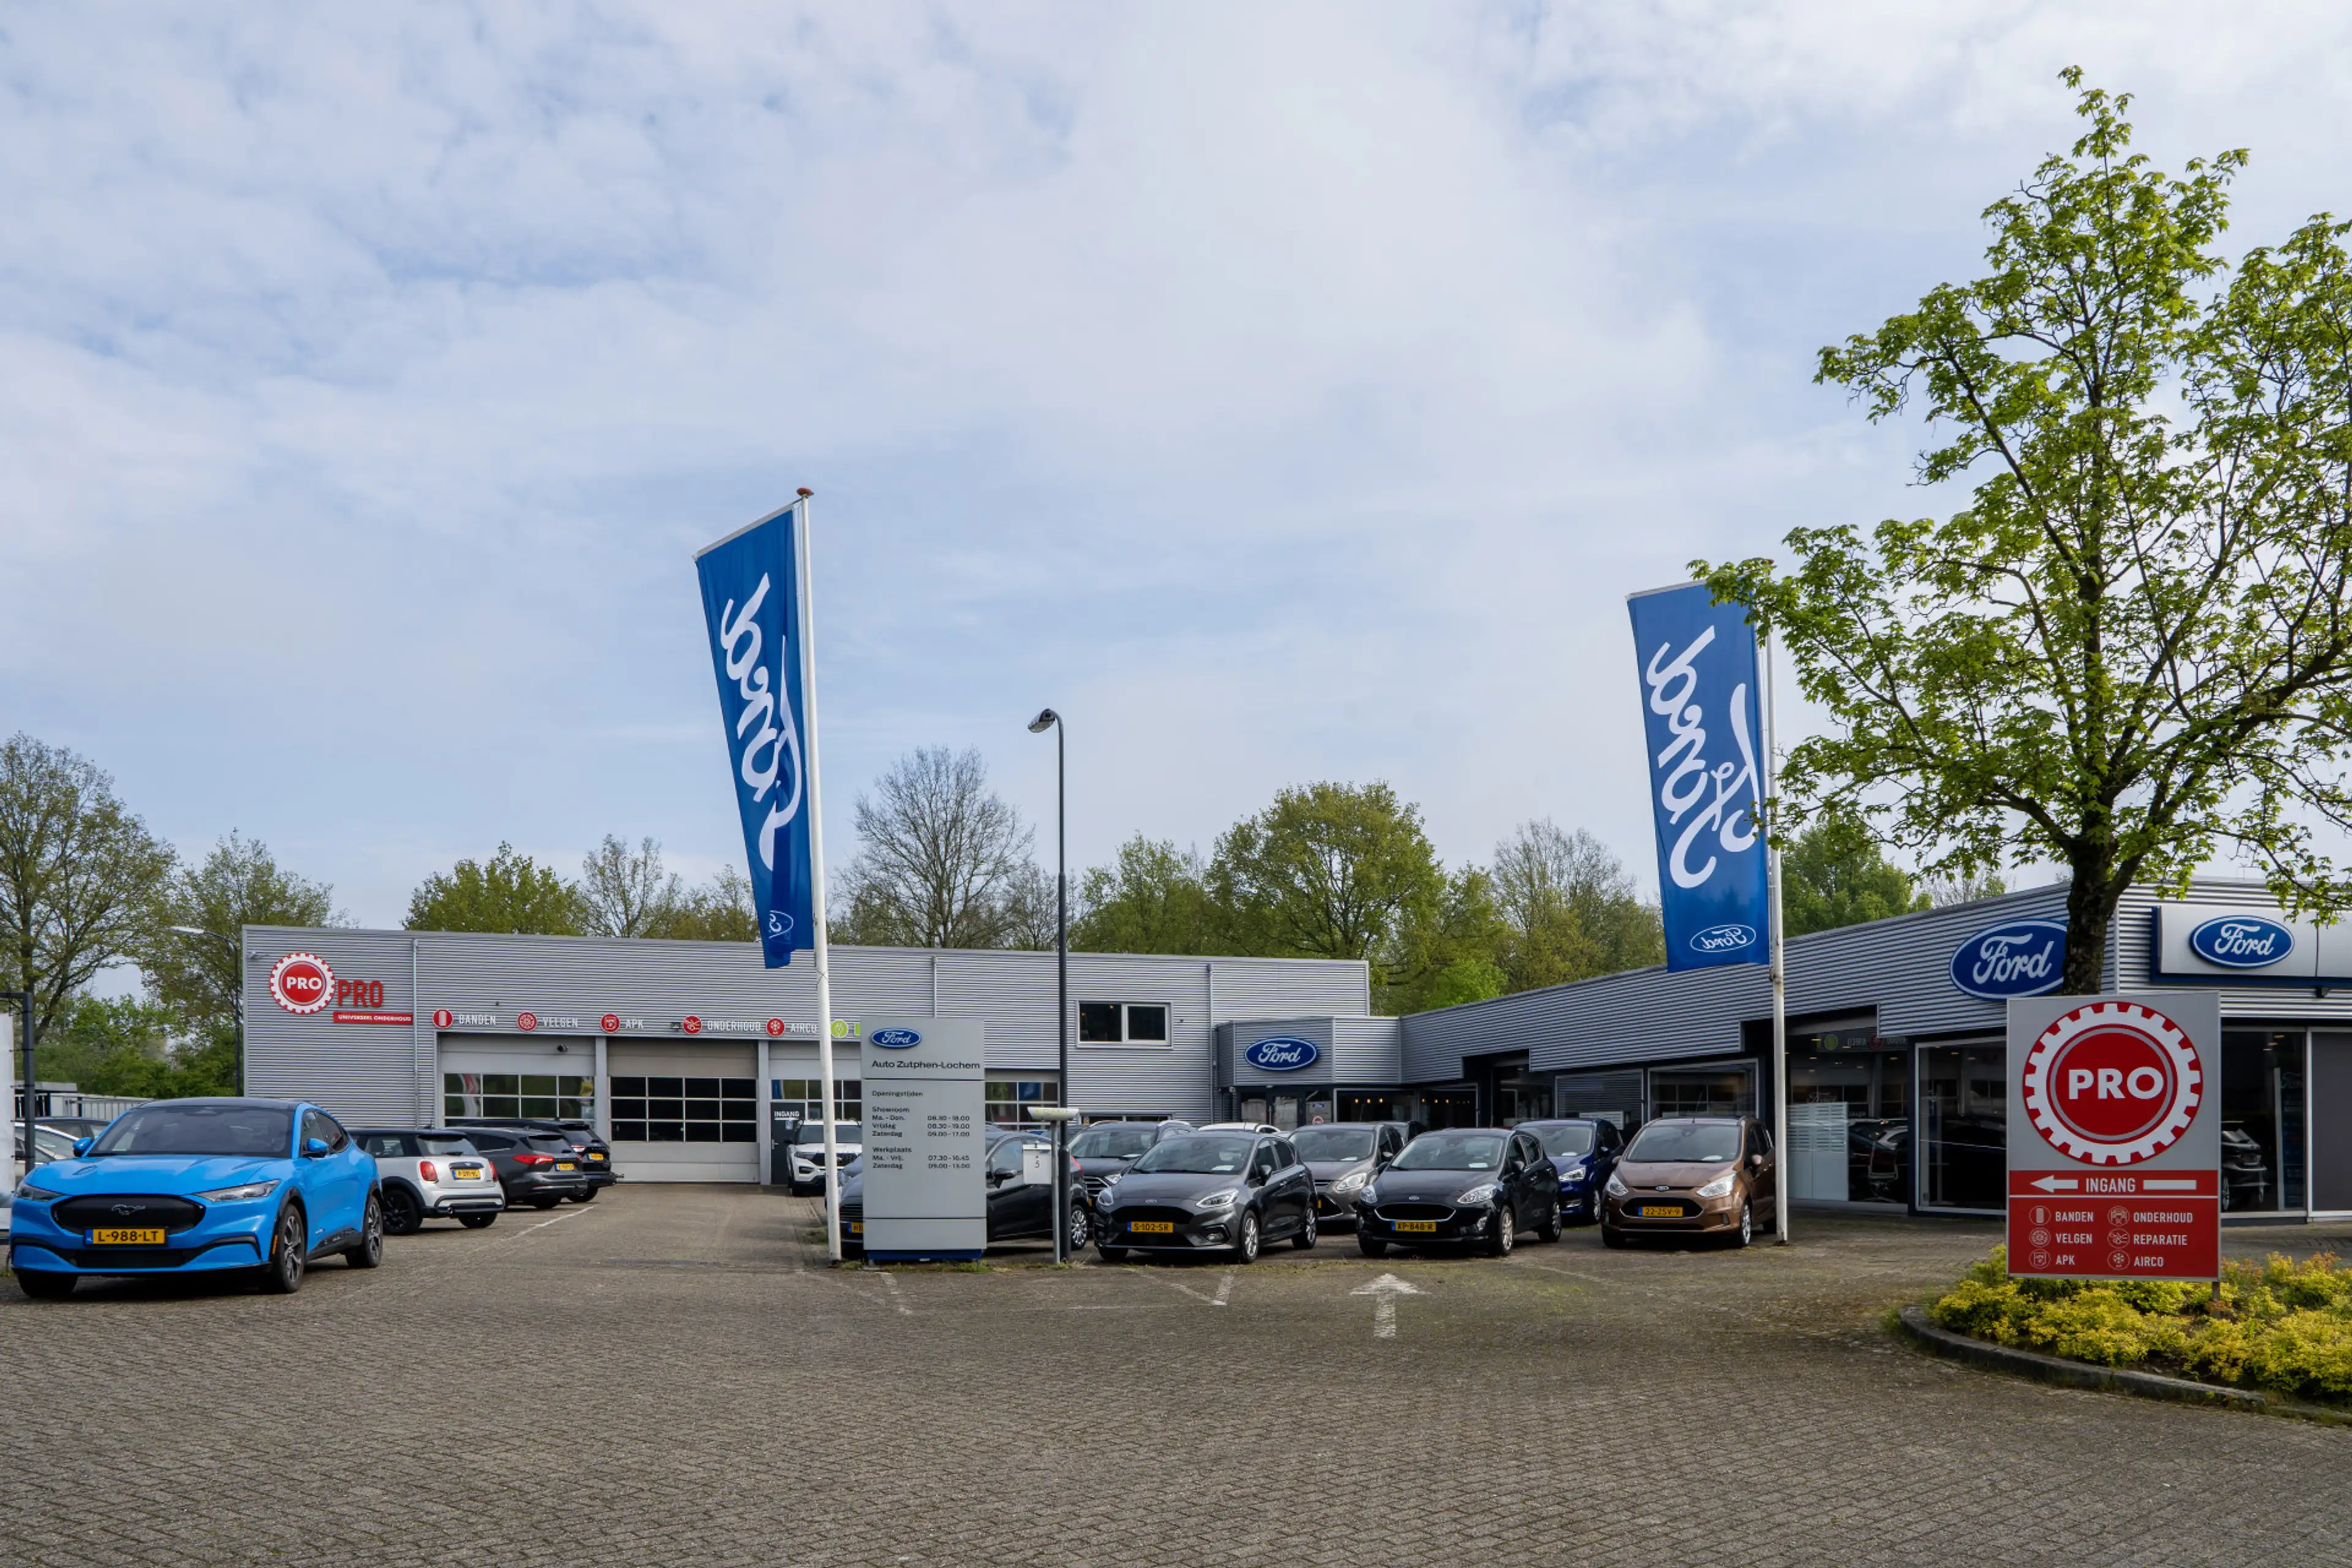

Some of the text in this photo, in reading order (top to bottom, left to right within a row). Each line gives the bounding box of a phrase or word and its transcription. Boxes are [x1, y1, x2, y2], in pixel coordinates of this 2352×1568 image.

[2214, 923, 2275, 956] Ford
[1972, 933, 2054, 984] Ford
[286, 977, 322, 990] PRO
[337, 980, 383, 1008] PRO
[459, 1014, 496, 1025] BANDEN
[543, 1017, 578, 1028] VELGEN
[625, 1019, 644, 1029] APK
[707, 1020, 761, 1031] ONDERHOUD
[790, 1023, 818, 1033] AIRCO
[881, 1031, 911, 1044] Ford
[1257, 1043, 1302, 1063] Ford
[897, 1061, 980, 1069] Zutphen-Lochem
[2068, 1066, 2164, 1099] PRO
[2086, 1178, 2136, 1193] INGANG
[2056, 1212, 2094, 1223] BANDEN
[2133, 1212, 2193, 1223] ONDERHOUD
[1134, 1223, 1169, 1231] S-102-SR
[98, 1231, 159, 1242] L-988-LT
[2056, 1233, 2092, 1244] VELGEN
[2133, 1234, 2187, 1246] REPARATIE
[2056, 1255, 2075, 1265] APK
[2133, 1256, 2164, 1268] AIRCO
